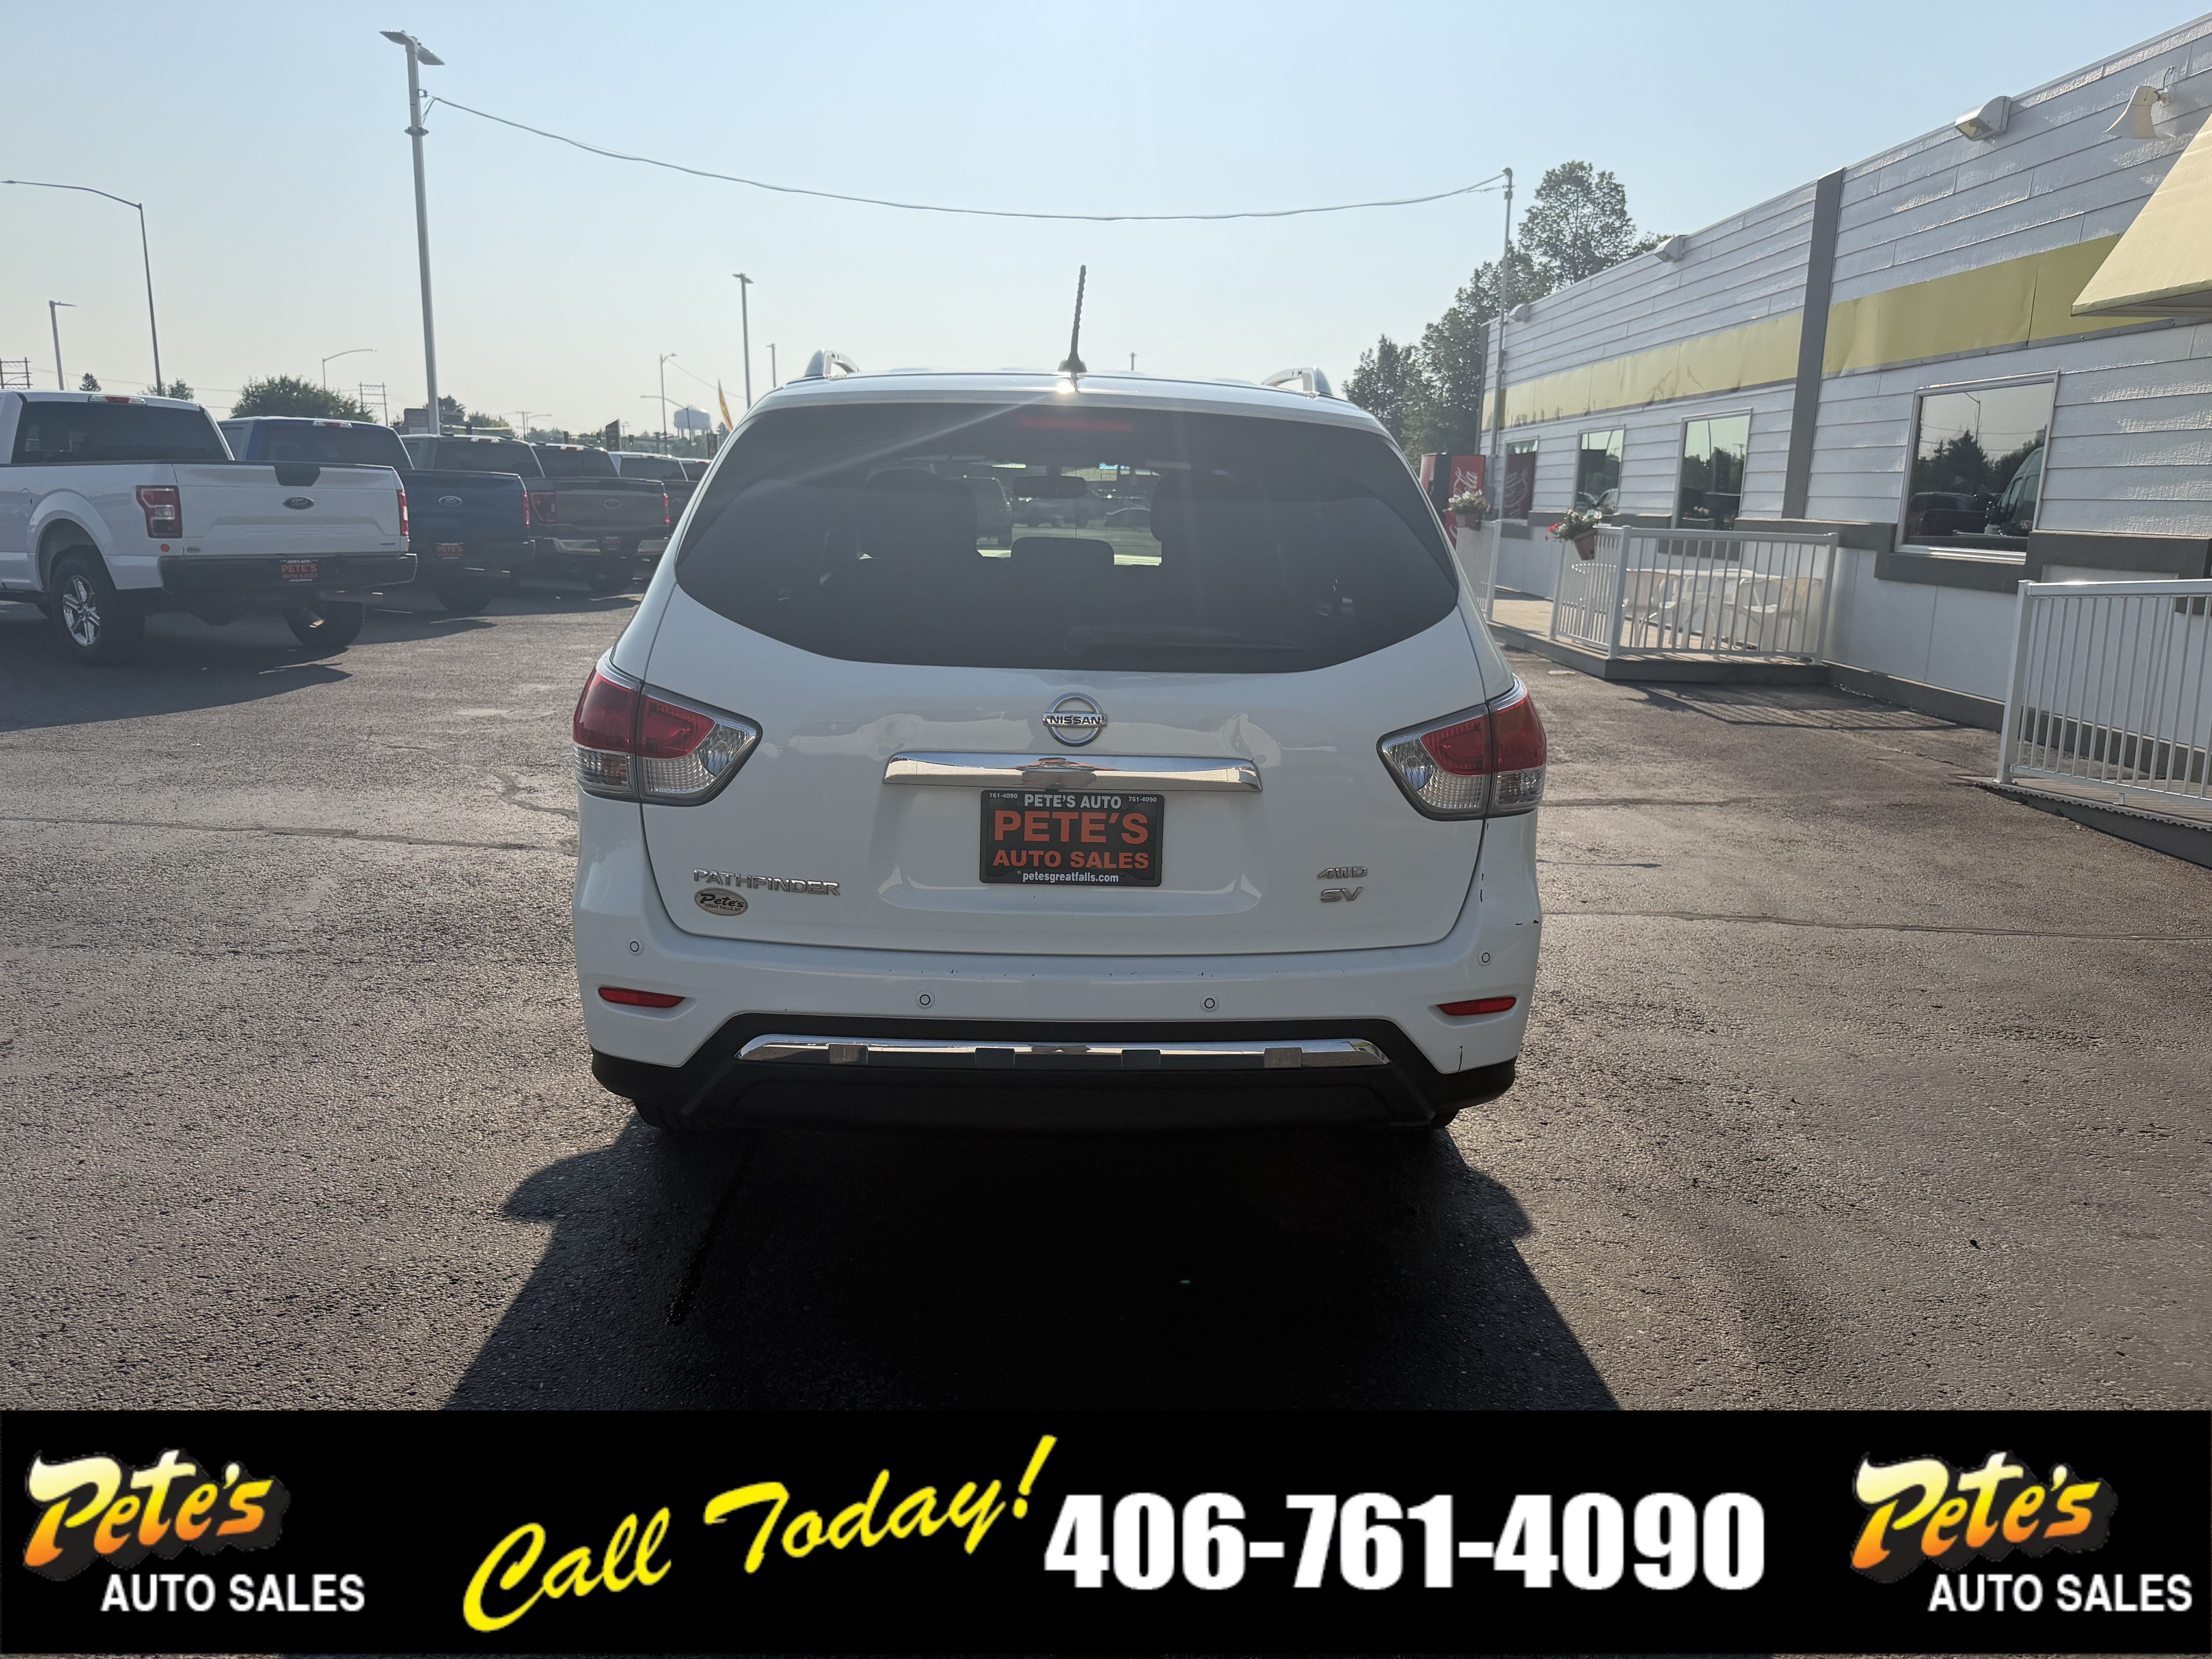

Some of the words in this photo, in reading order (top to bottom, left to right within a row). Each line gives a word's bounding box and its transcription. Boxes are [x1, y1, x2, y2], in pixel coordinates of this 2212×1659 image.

[282, 564, 317, 572] PETE'S
[1050, 715, 1100, 725] NISSAN
[1024, 794, 1076, 808] PETE'S
[1080, 796, 1122, 809] AUTO
[994, 810, 1149, 845] PETE'S
[993, 850, 1061, 868] AUTO
[1070, 852, 1149, 869] SALES
[1022, 870, 1119, 883] petesgreatfalls.com
[1318, 866, 1368, 879] 4WD
[694, 867, 840, 896] PATHFINDER
[700, 893, 744, 908] Pete's
[1321, 887, 1364, 902] SV
